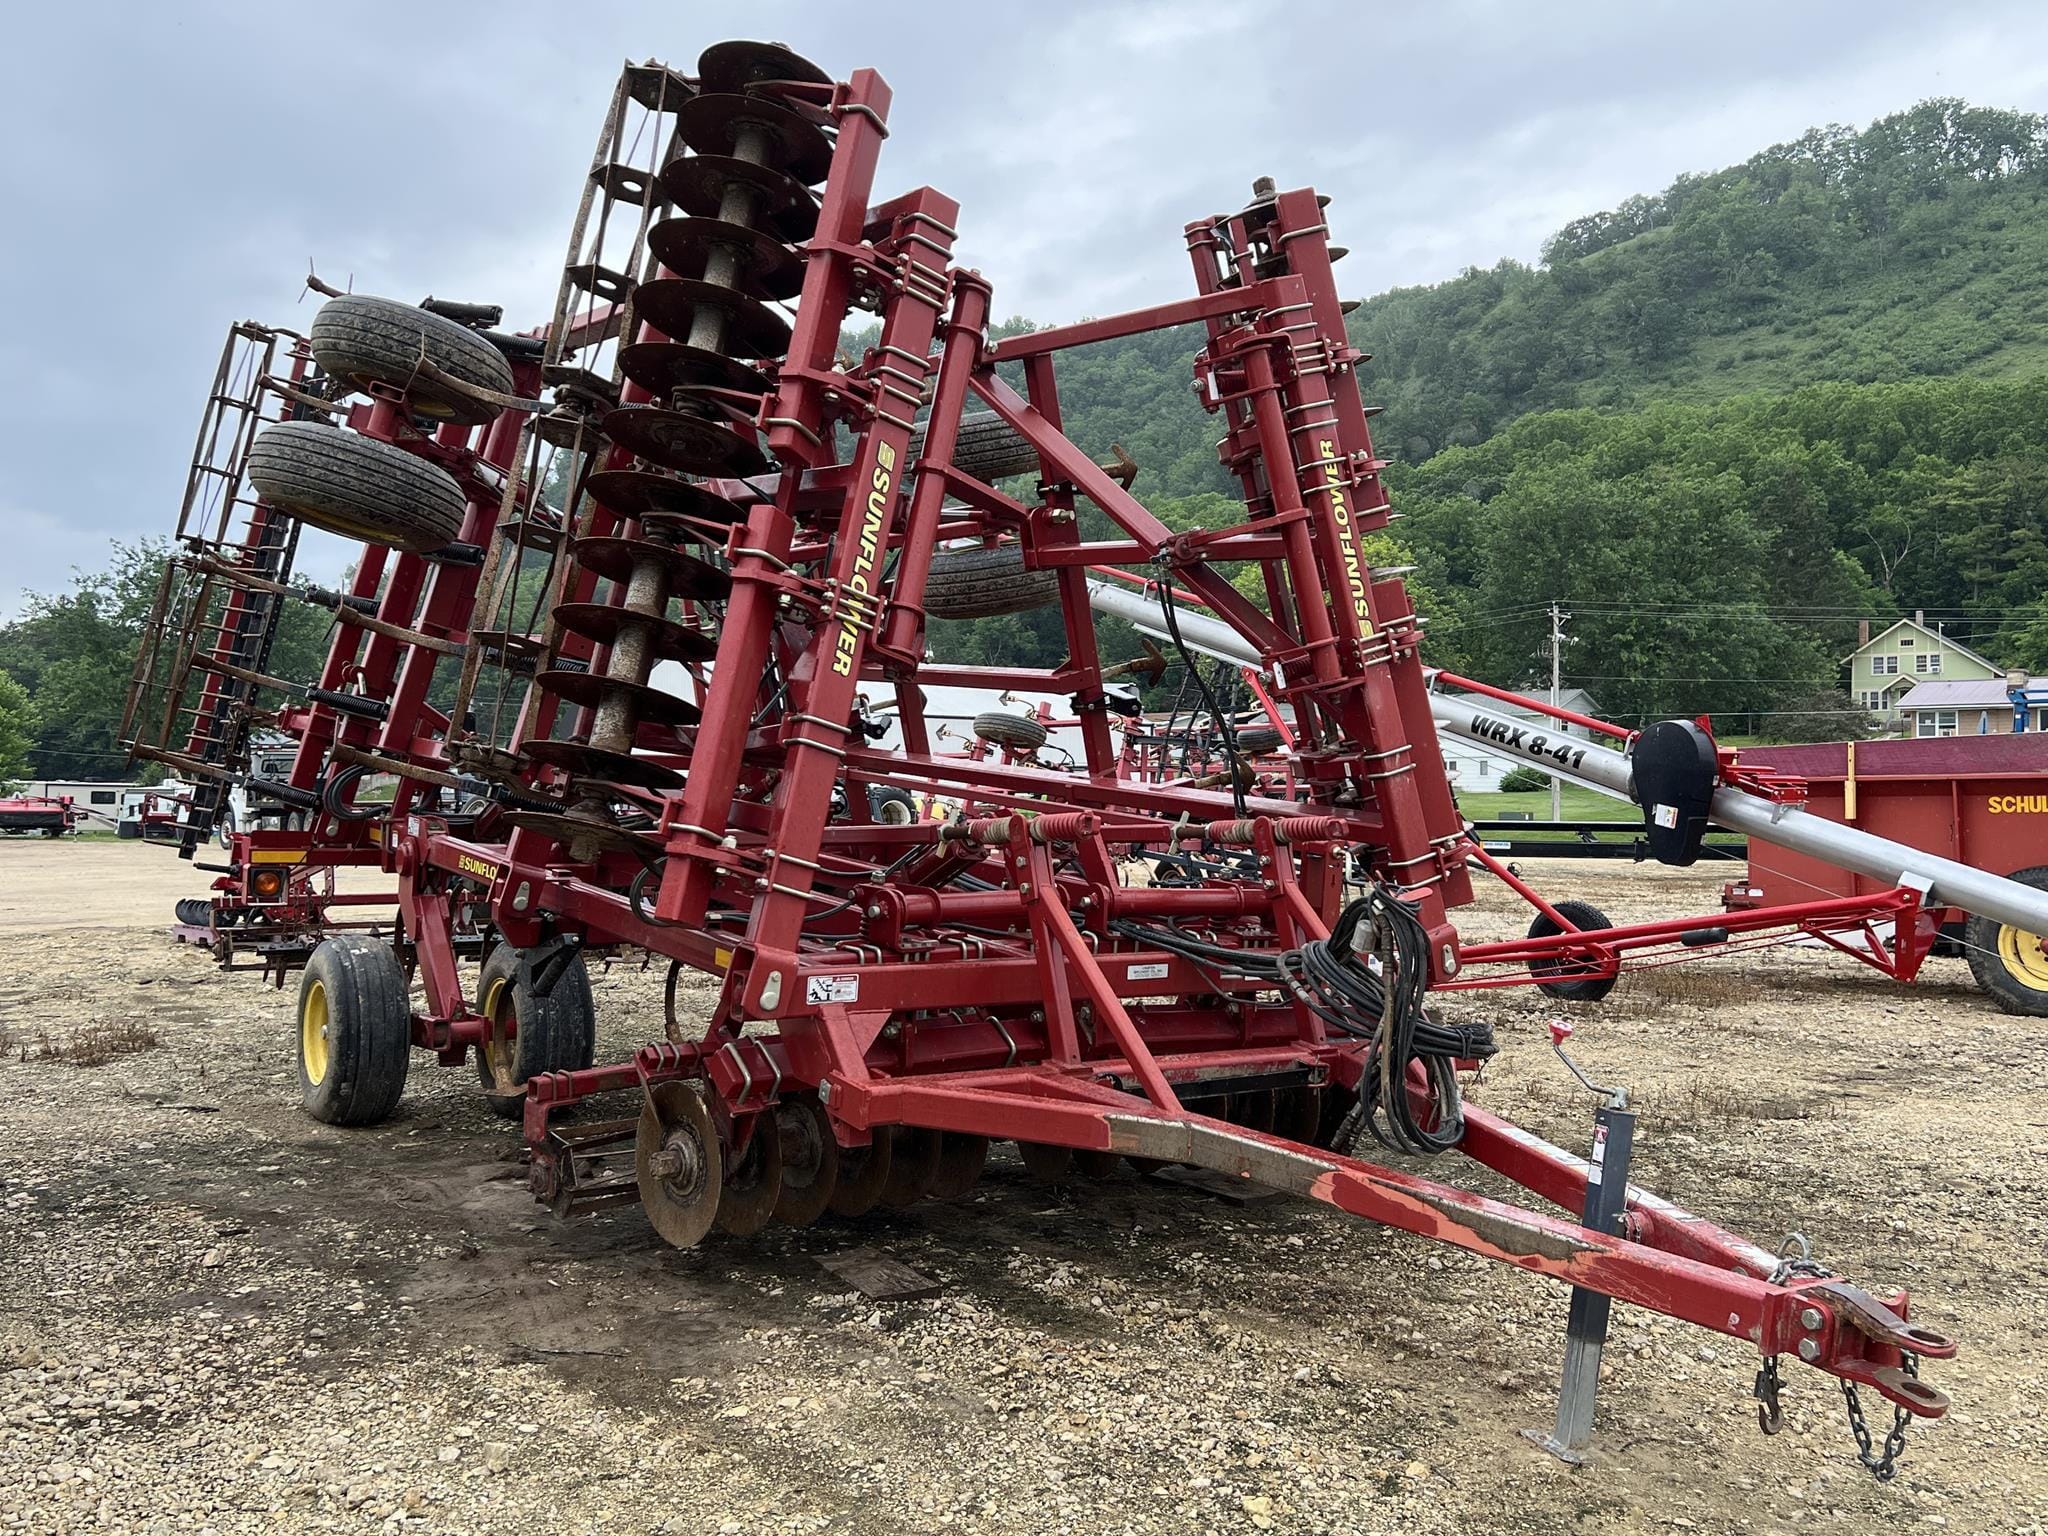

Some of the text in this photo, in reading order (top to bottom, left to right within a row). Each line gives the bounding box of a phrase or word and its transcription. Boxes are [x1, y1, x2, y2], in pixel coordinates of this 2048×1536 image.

[1319, 439, 1370, 618] SUNFLOWER
[1471, 714, 1588, 770] WRX 8-41
